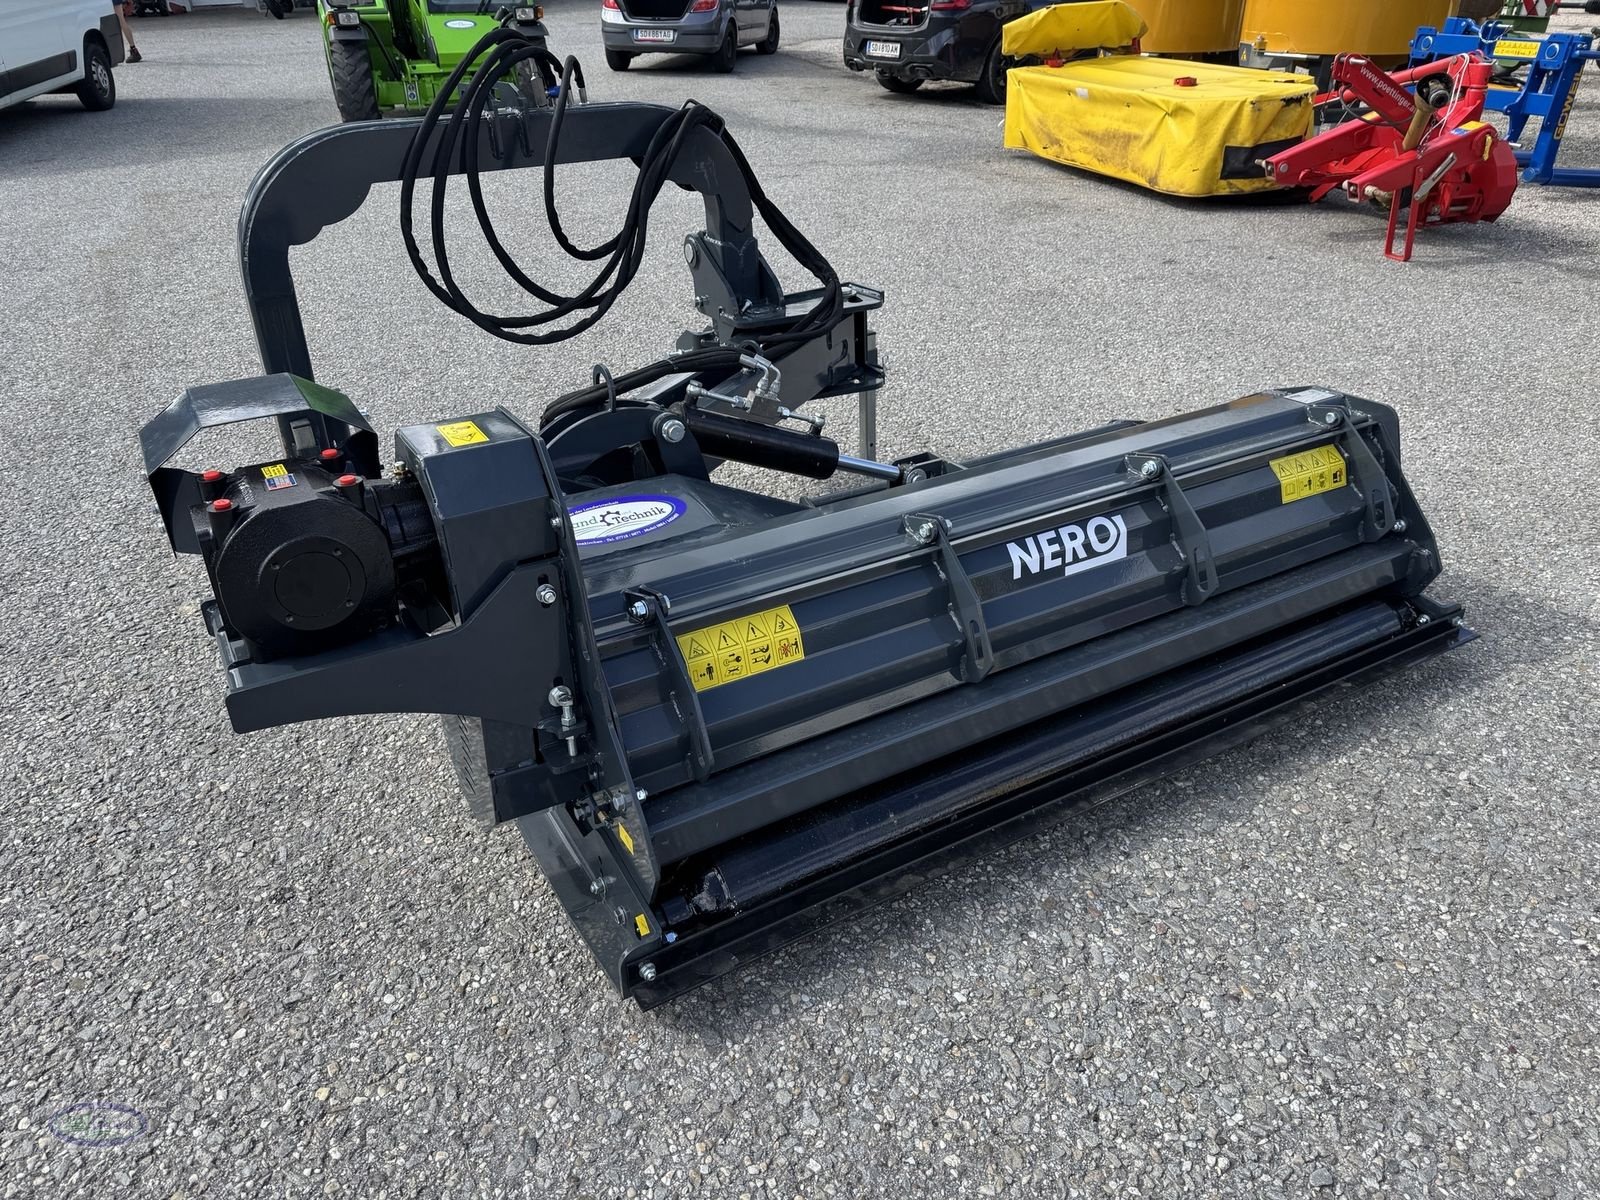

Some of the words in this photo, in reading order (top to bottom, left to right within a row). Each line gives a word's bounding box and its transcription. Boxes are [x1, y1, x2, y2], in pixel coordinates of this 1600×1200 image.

[573, 516, 597, 528] and
[612, 506, 667, 525] Technik
[1006, 516, 1118, 580] NERO
